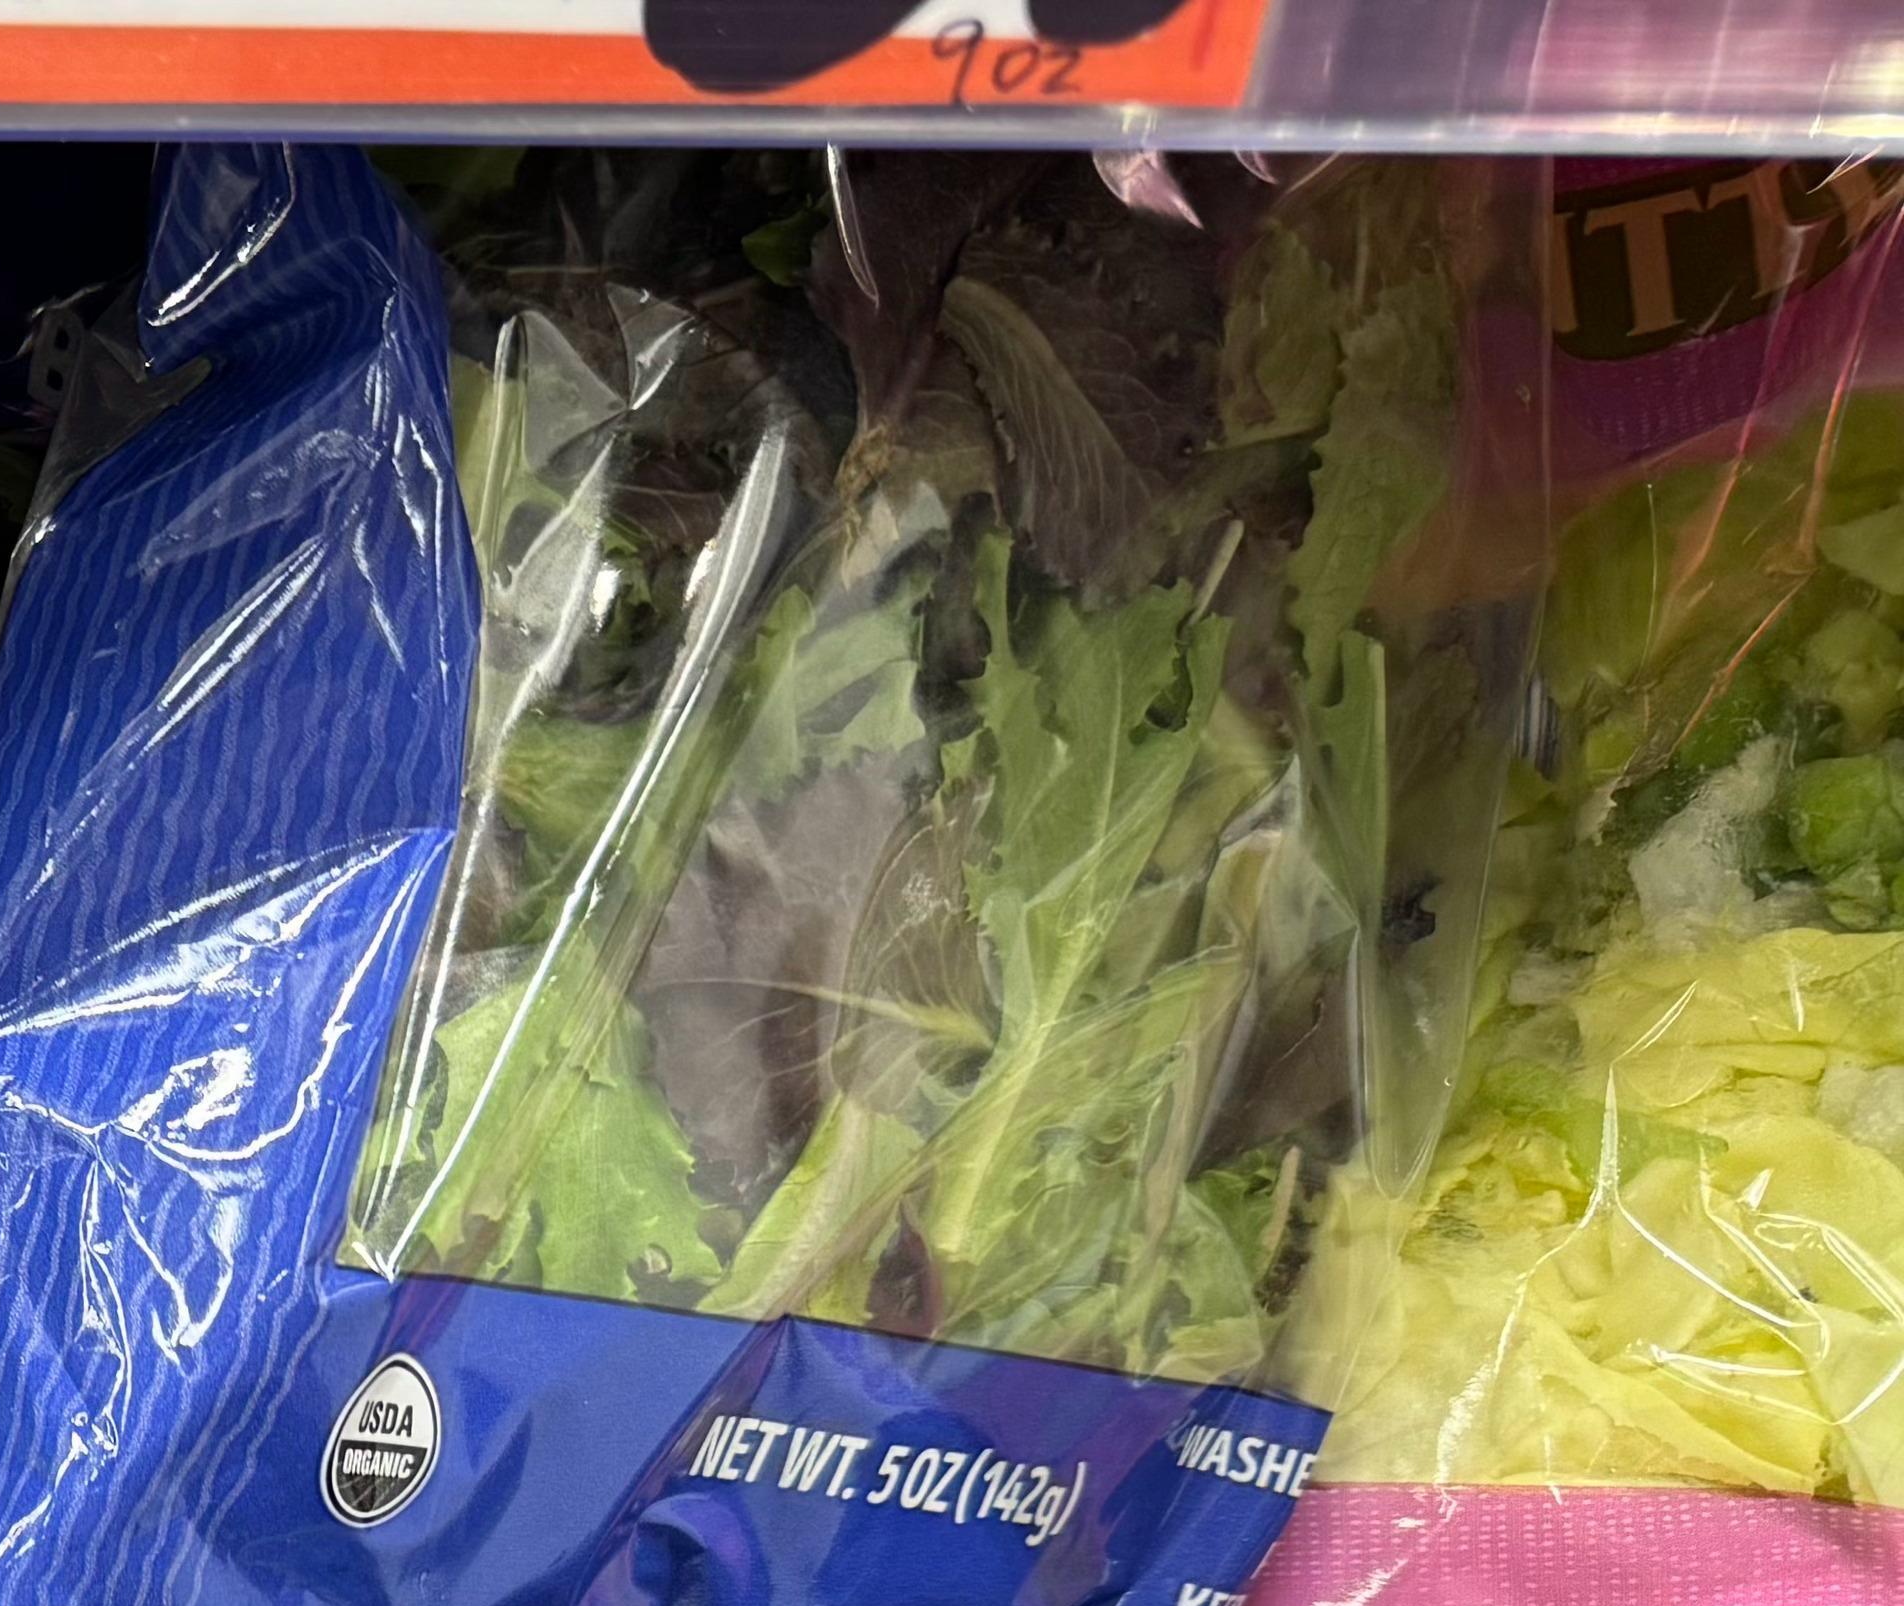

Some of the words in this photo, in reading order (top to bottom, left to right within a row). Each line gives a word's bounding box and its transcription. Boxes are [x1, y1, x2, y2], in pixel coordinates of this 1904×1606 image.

[358, 1398, 413, 1438] USDA
[342, 1447, 414, 1480] ORGANIC
[688, 1415, 789, 1482] NET
[776, 1425, 869, 1500] WT.
